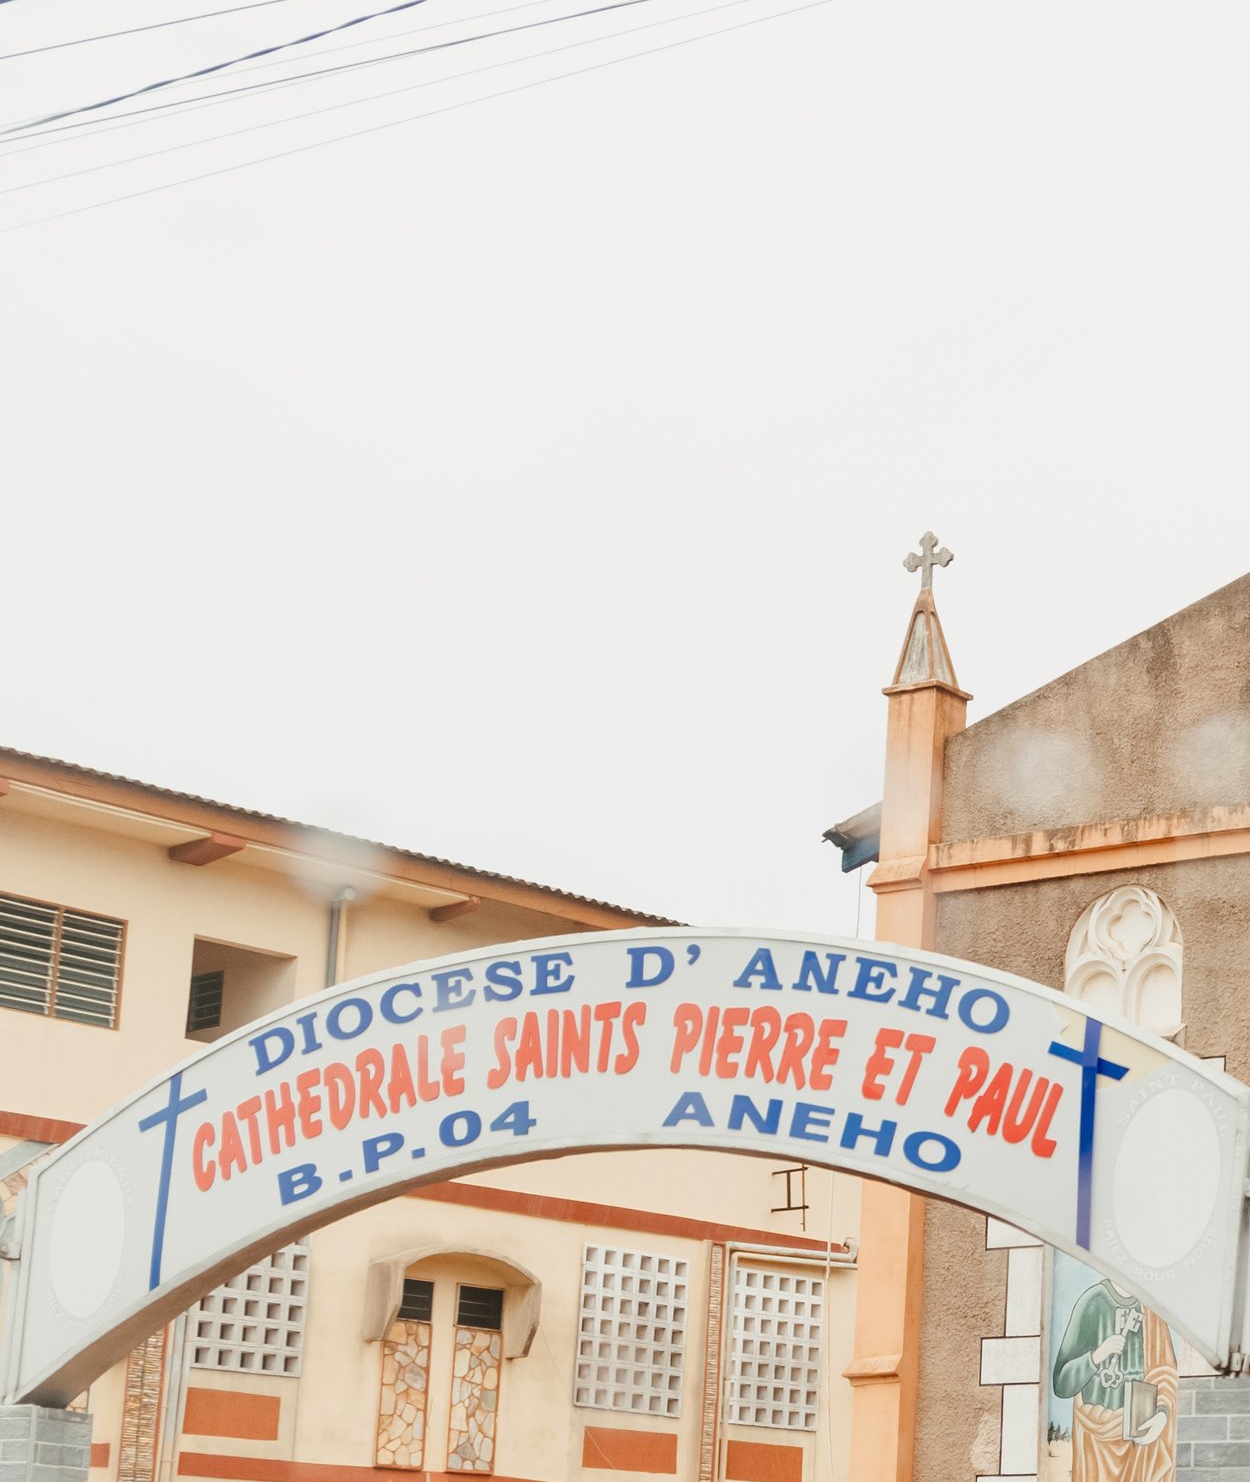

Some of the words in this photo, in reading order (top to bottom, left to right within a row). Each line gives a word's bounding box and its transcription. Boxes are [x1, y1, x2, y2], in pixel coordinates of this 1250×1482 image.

[248, 951, 576, 1076] DIOCESE
[624, 943, 701, 989] D'
[733, 947, 1011, 1035] ANEHO
[191, 1025, 467, 1192] CATHEDRALE
[486, 1001, 647, 1091] SAINTS
[669, 1001, 849, 1092] PIERRE
[860, 1027, 937, 1106] ET
[943, 1045, 1066, 1159] PAUL
[661, 1090, 963, 1173] ANEHO
[1115, 1072, 1182, 1130] SAINT
[1189, 1077, 1231, 1139] PAUL
[1132, 1265, 1178, 1284] POUR
[1181, 1223, 1218, 1272] NOUS
